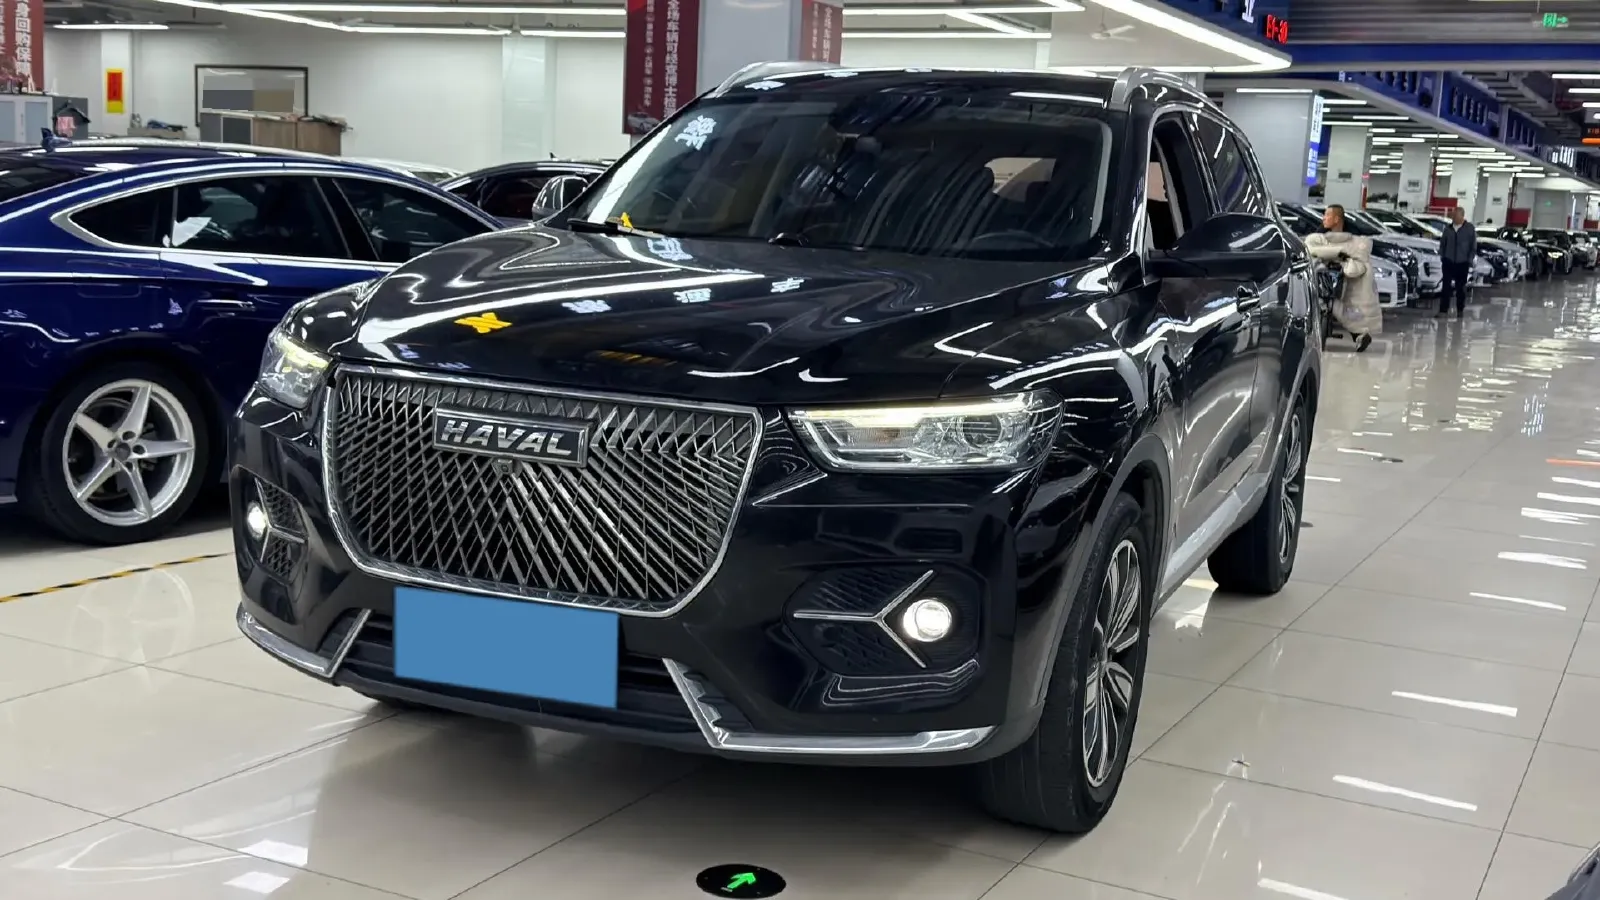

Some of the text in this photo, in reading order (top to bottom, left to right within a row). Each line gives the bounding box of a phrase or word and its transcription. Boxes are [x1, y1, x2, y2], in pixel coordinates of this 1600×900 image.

[15, 0, 32, 75] 身回购保障
[440, 419, 572, 456] HAVAL
